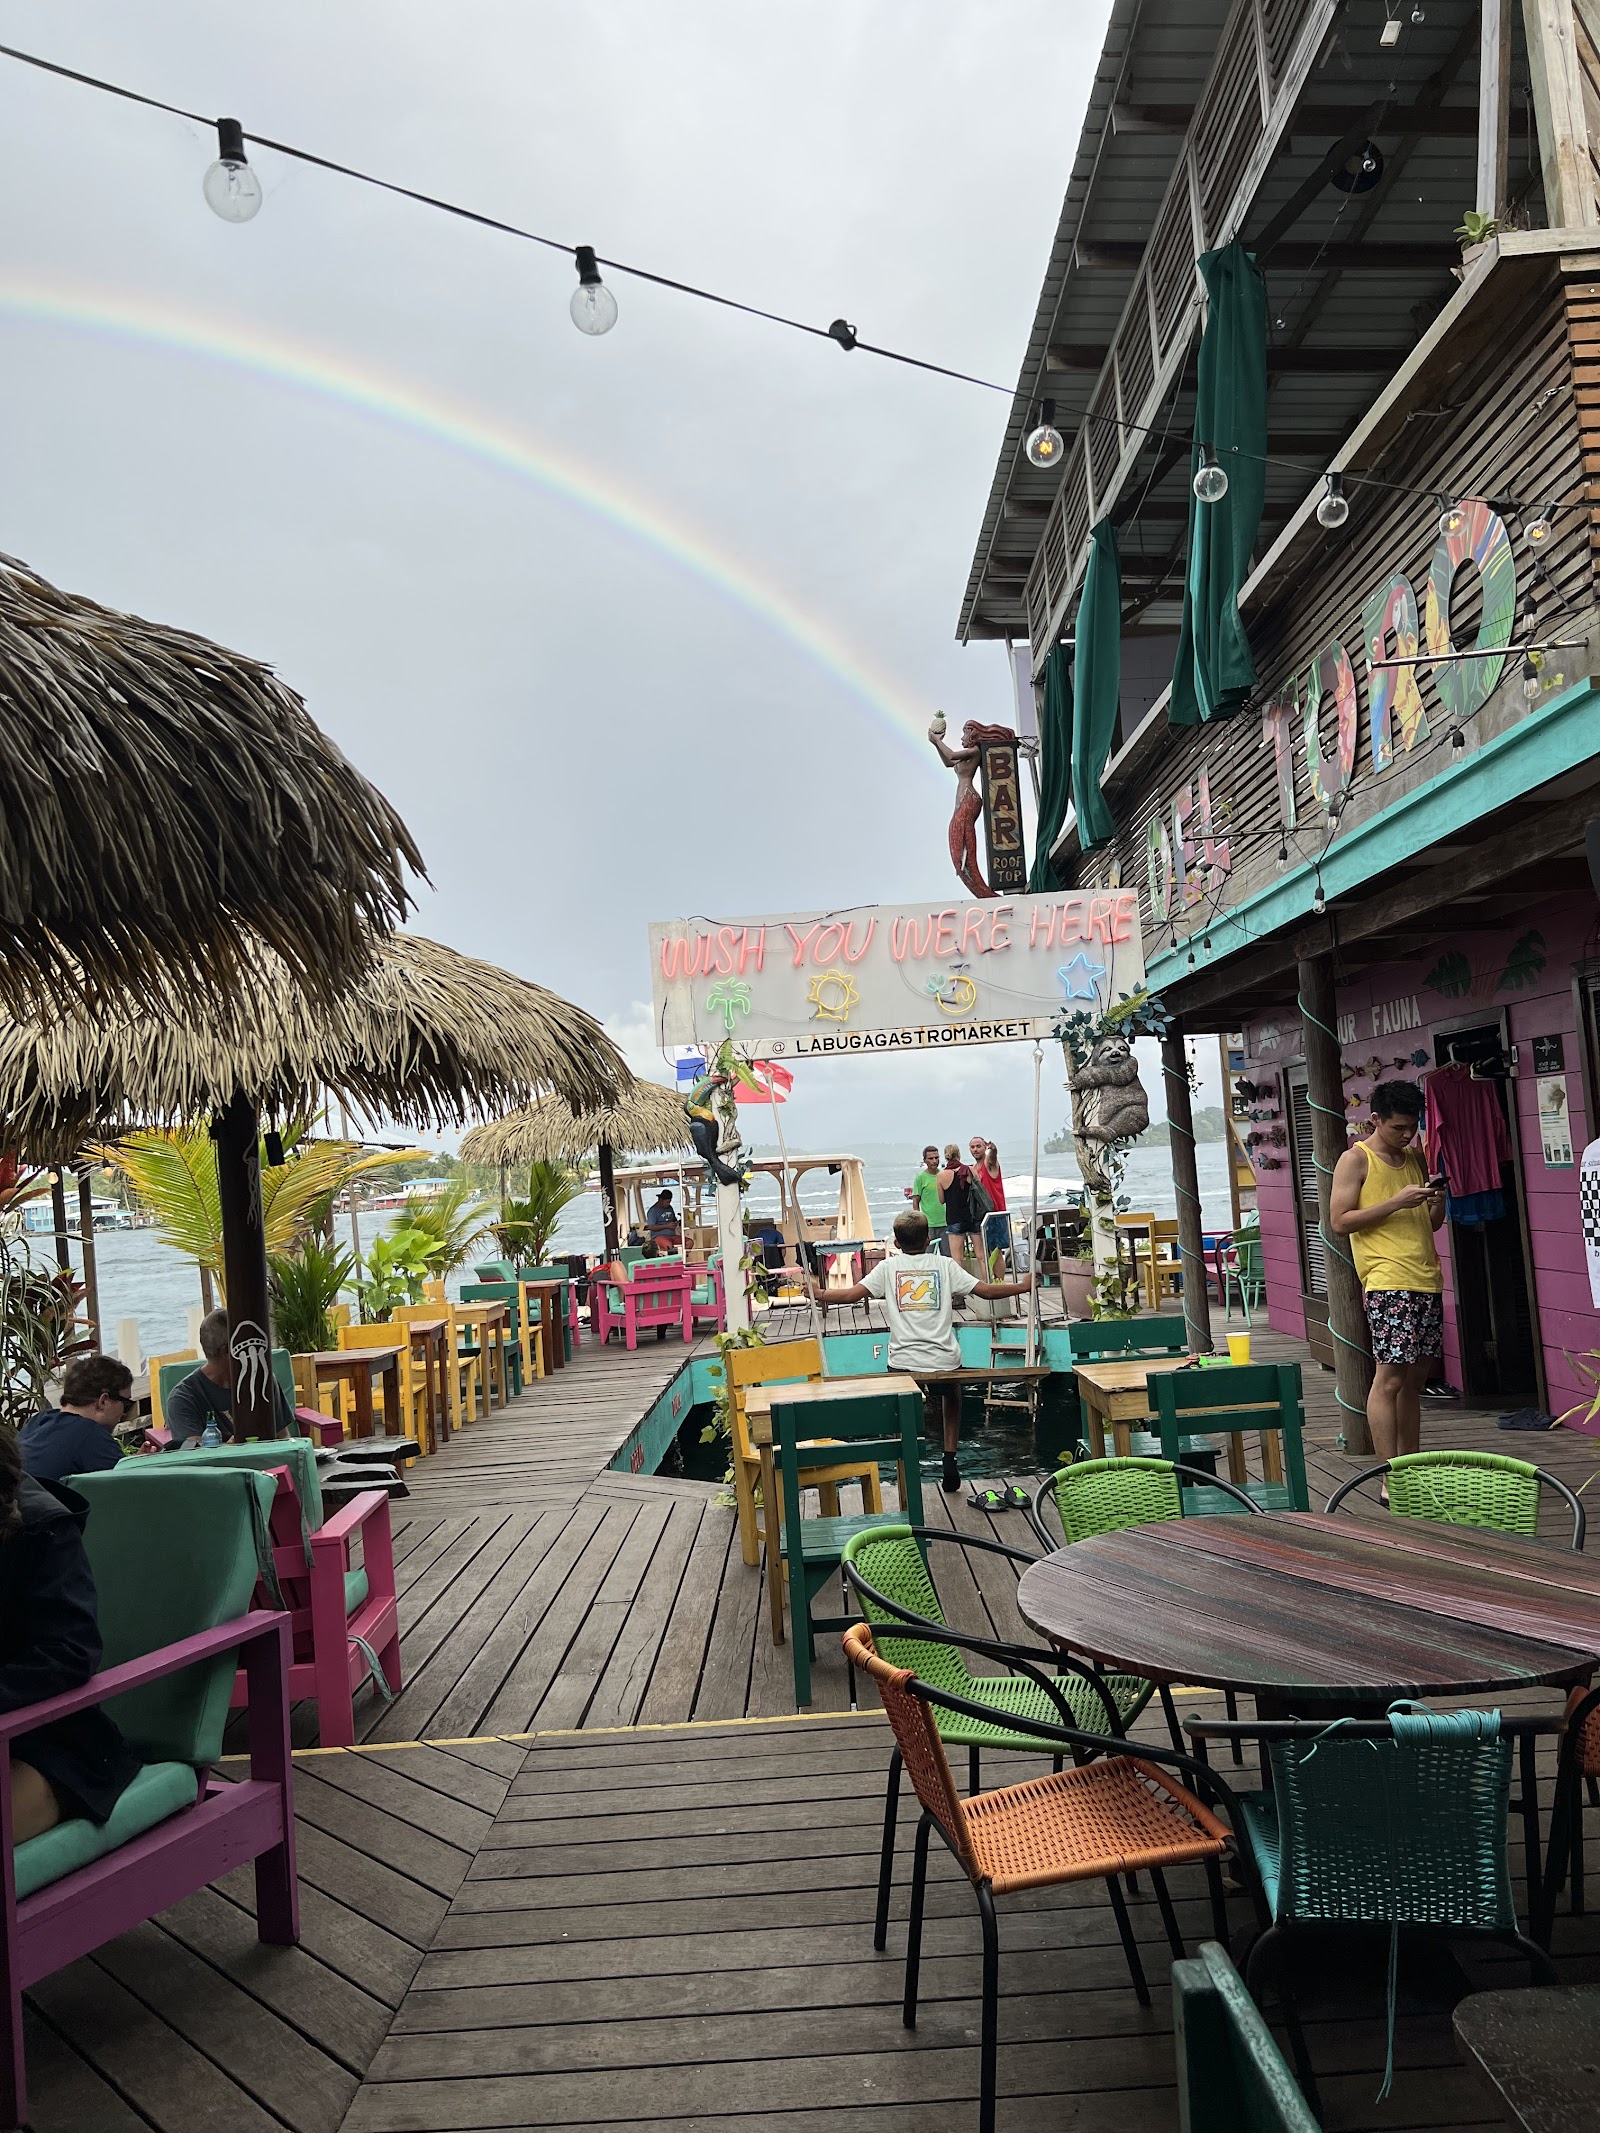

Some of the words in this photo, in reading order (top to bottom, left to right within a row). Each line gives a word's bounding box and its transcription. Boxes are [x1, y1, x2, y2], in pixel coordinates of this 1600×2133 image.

[1262, 496, 1517, 828] TORO
[988, 752, 1017, 845] BAR
[993, 855, 1024, 869] ROOF
[997, 869, 1022, 882] TOP
[661, 926, 766, 979] WISH
[786, 916, 877, 966] YOU
[892, 906, 1013, 962] WERE
[1029, 894, 1137, 948] HERE
[1372, 995, 1422, 1037] FAUNA
[796, 1022, 1030, 1053] LABUGAGASTROMARKET
